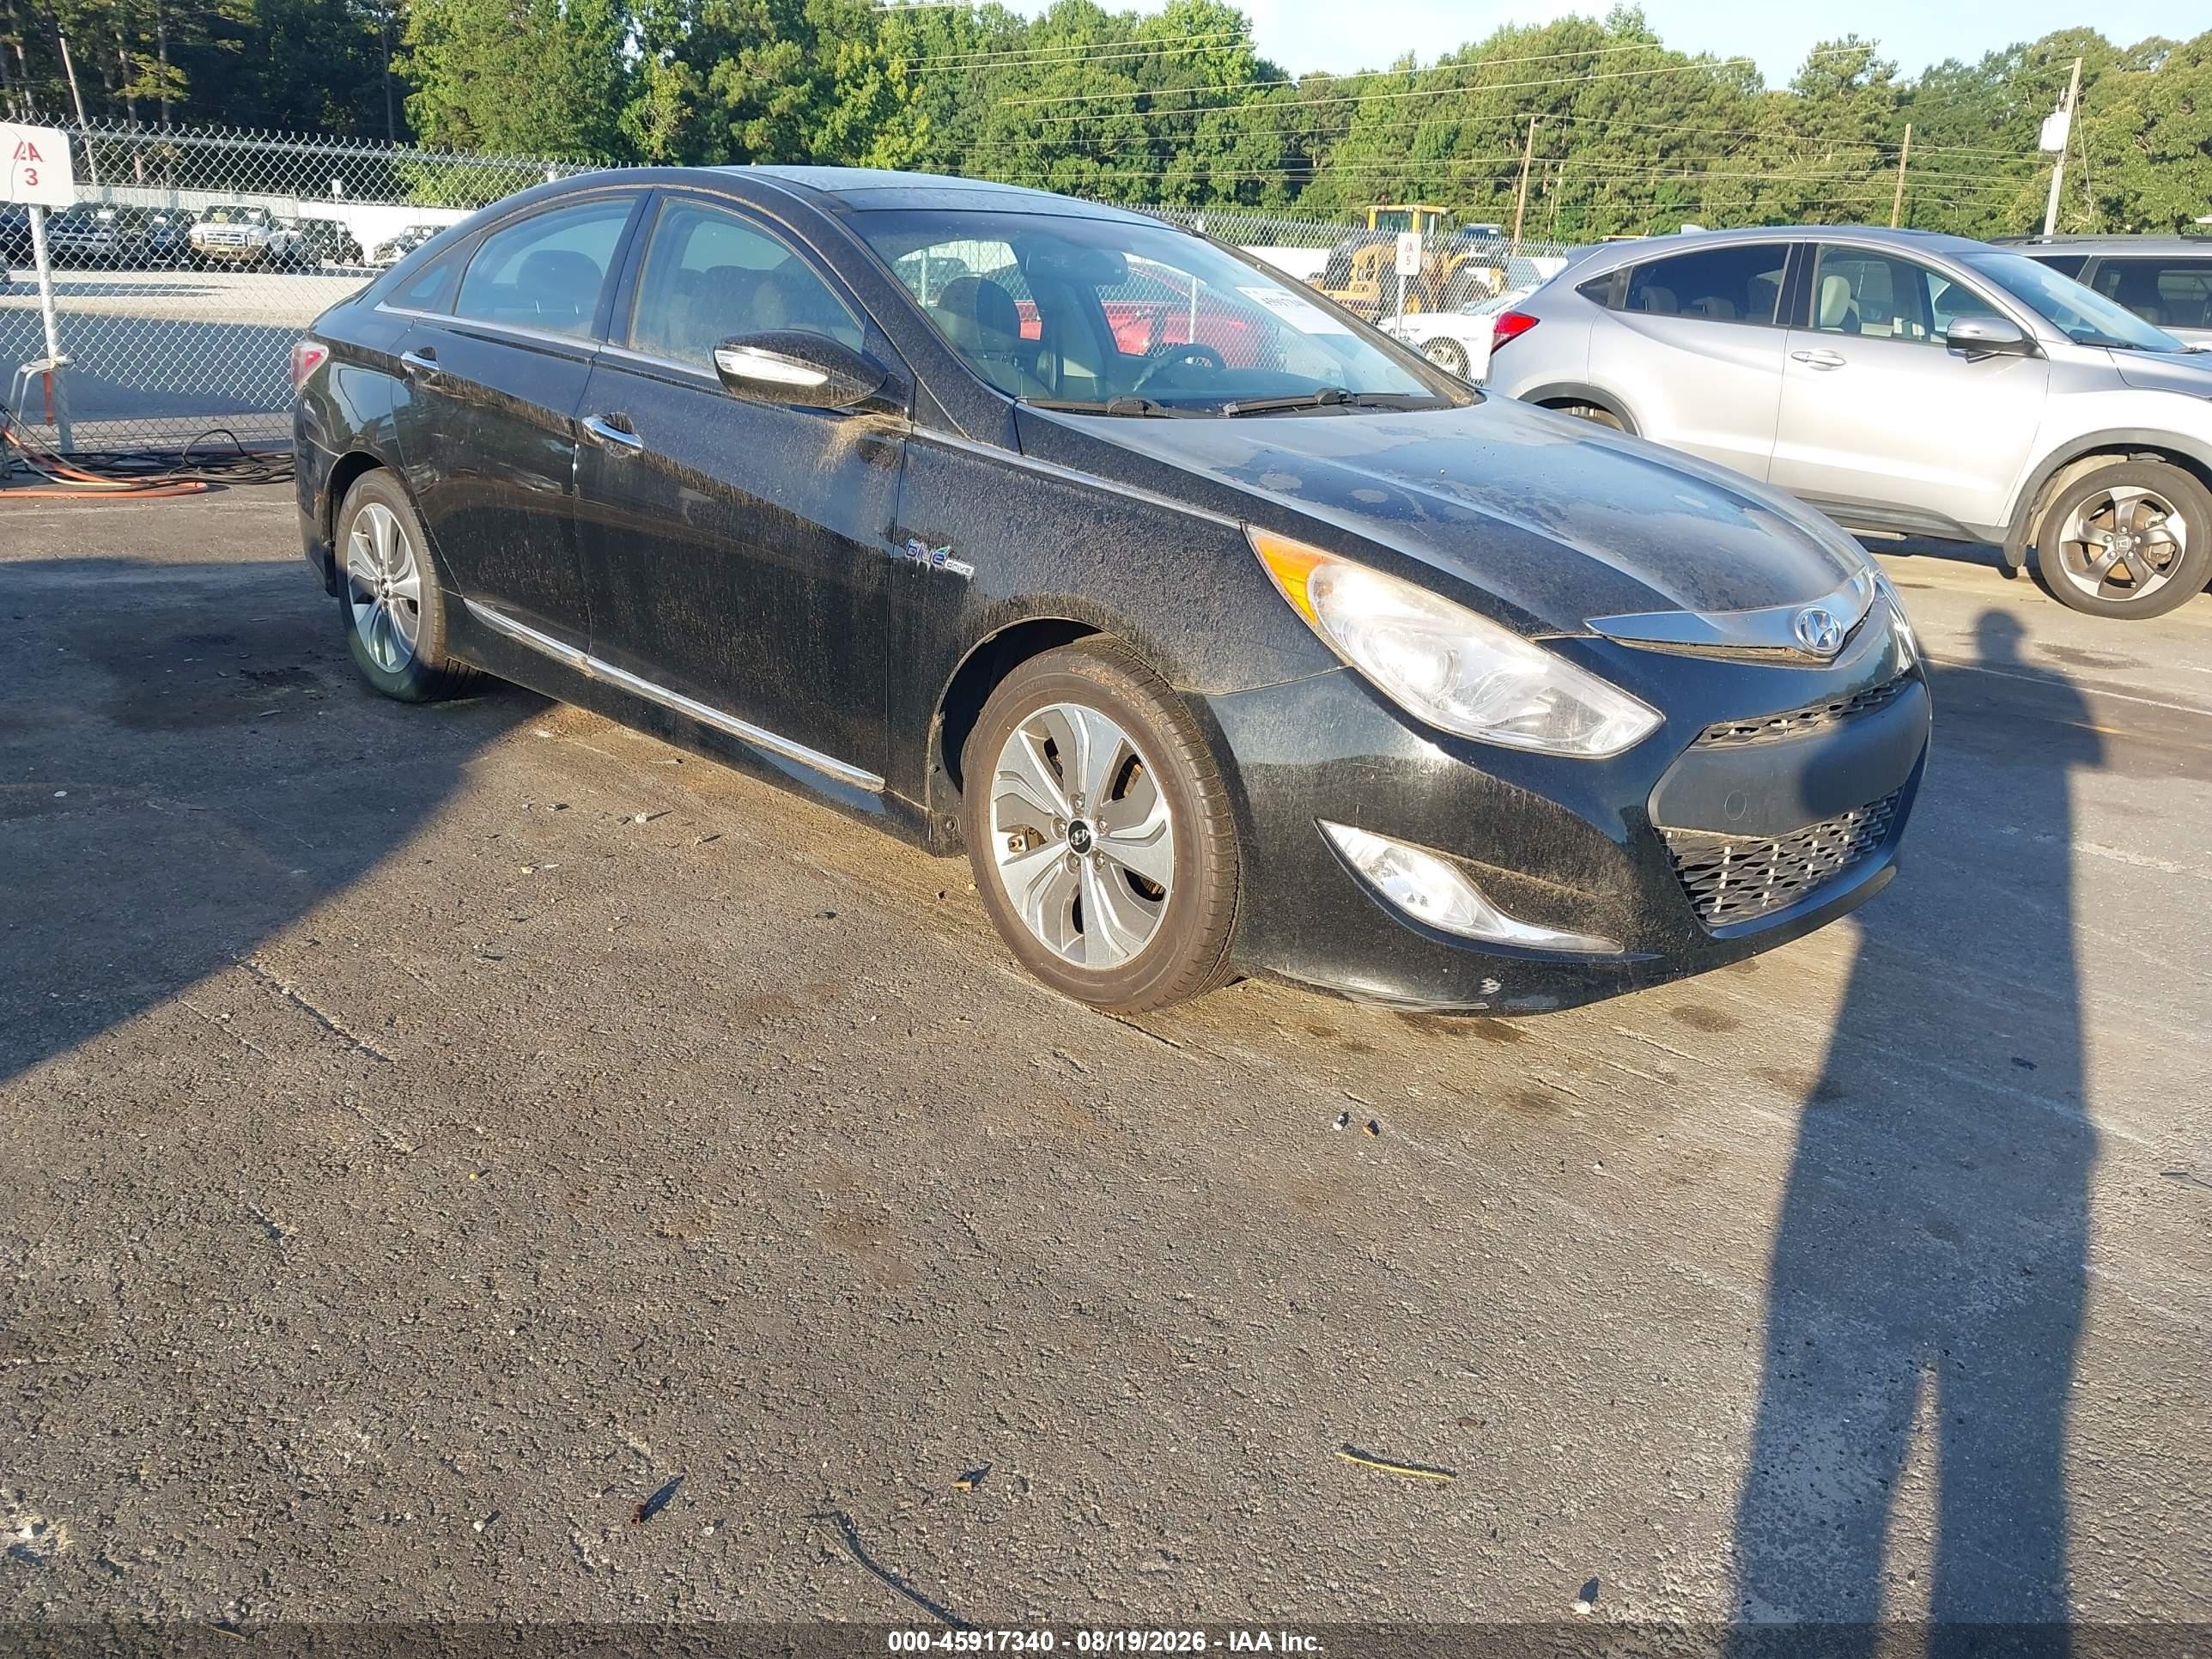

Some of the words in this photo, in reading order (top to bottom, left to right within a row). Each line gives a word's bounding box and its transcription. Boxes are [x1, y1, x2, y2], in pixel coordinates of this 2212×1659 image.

[24, 167, 39, 186] 3
[1406, 255, 1411, 265] 5
[905, 539, 945, 567] blue
[946, 562, 972, 574] drive
